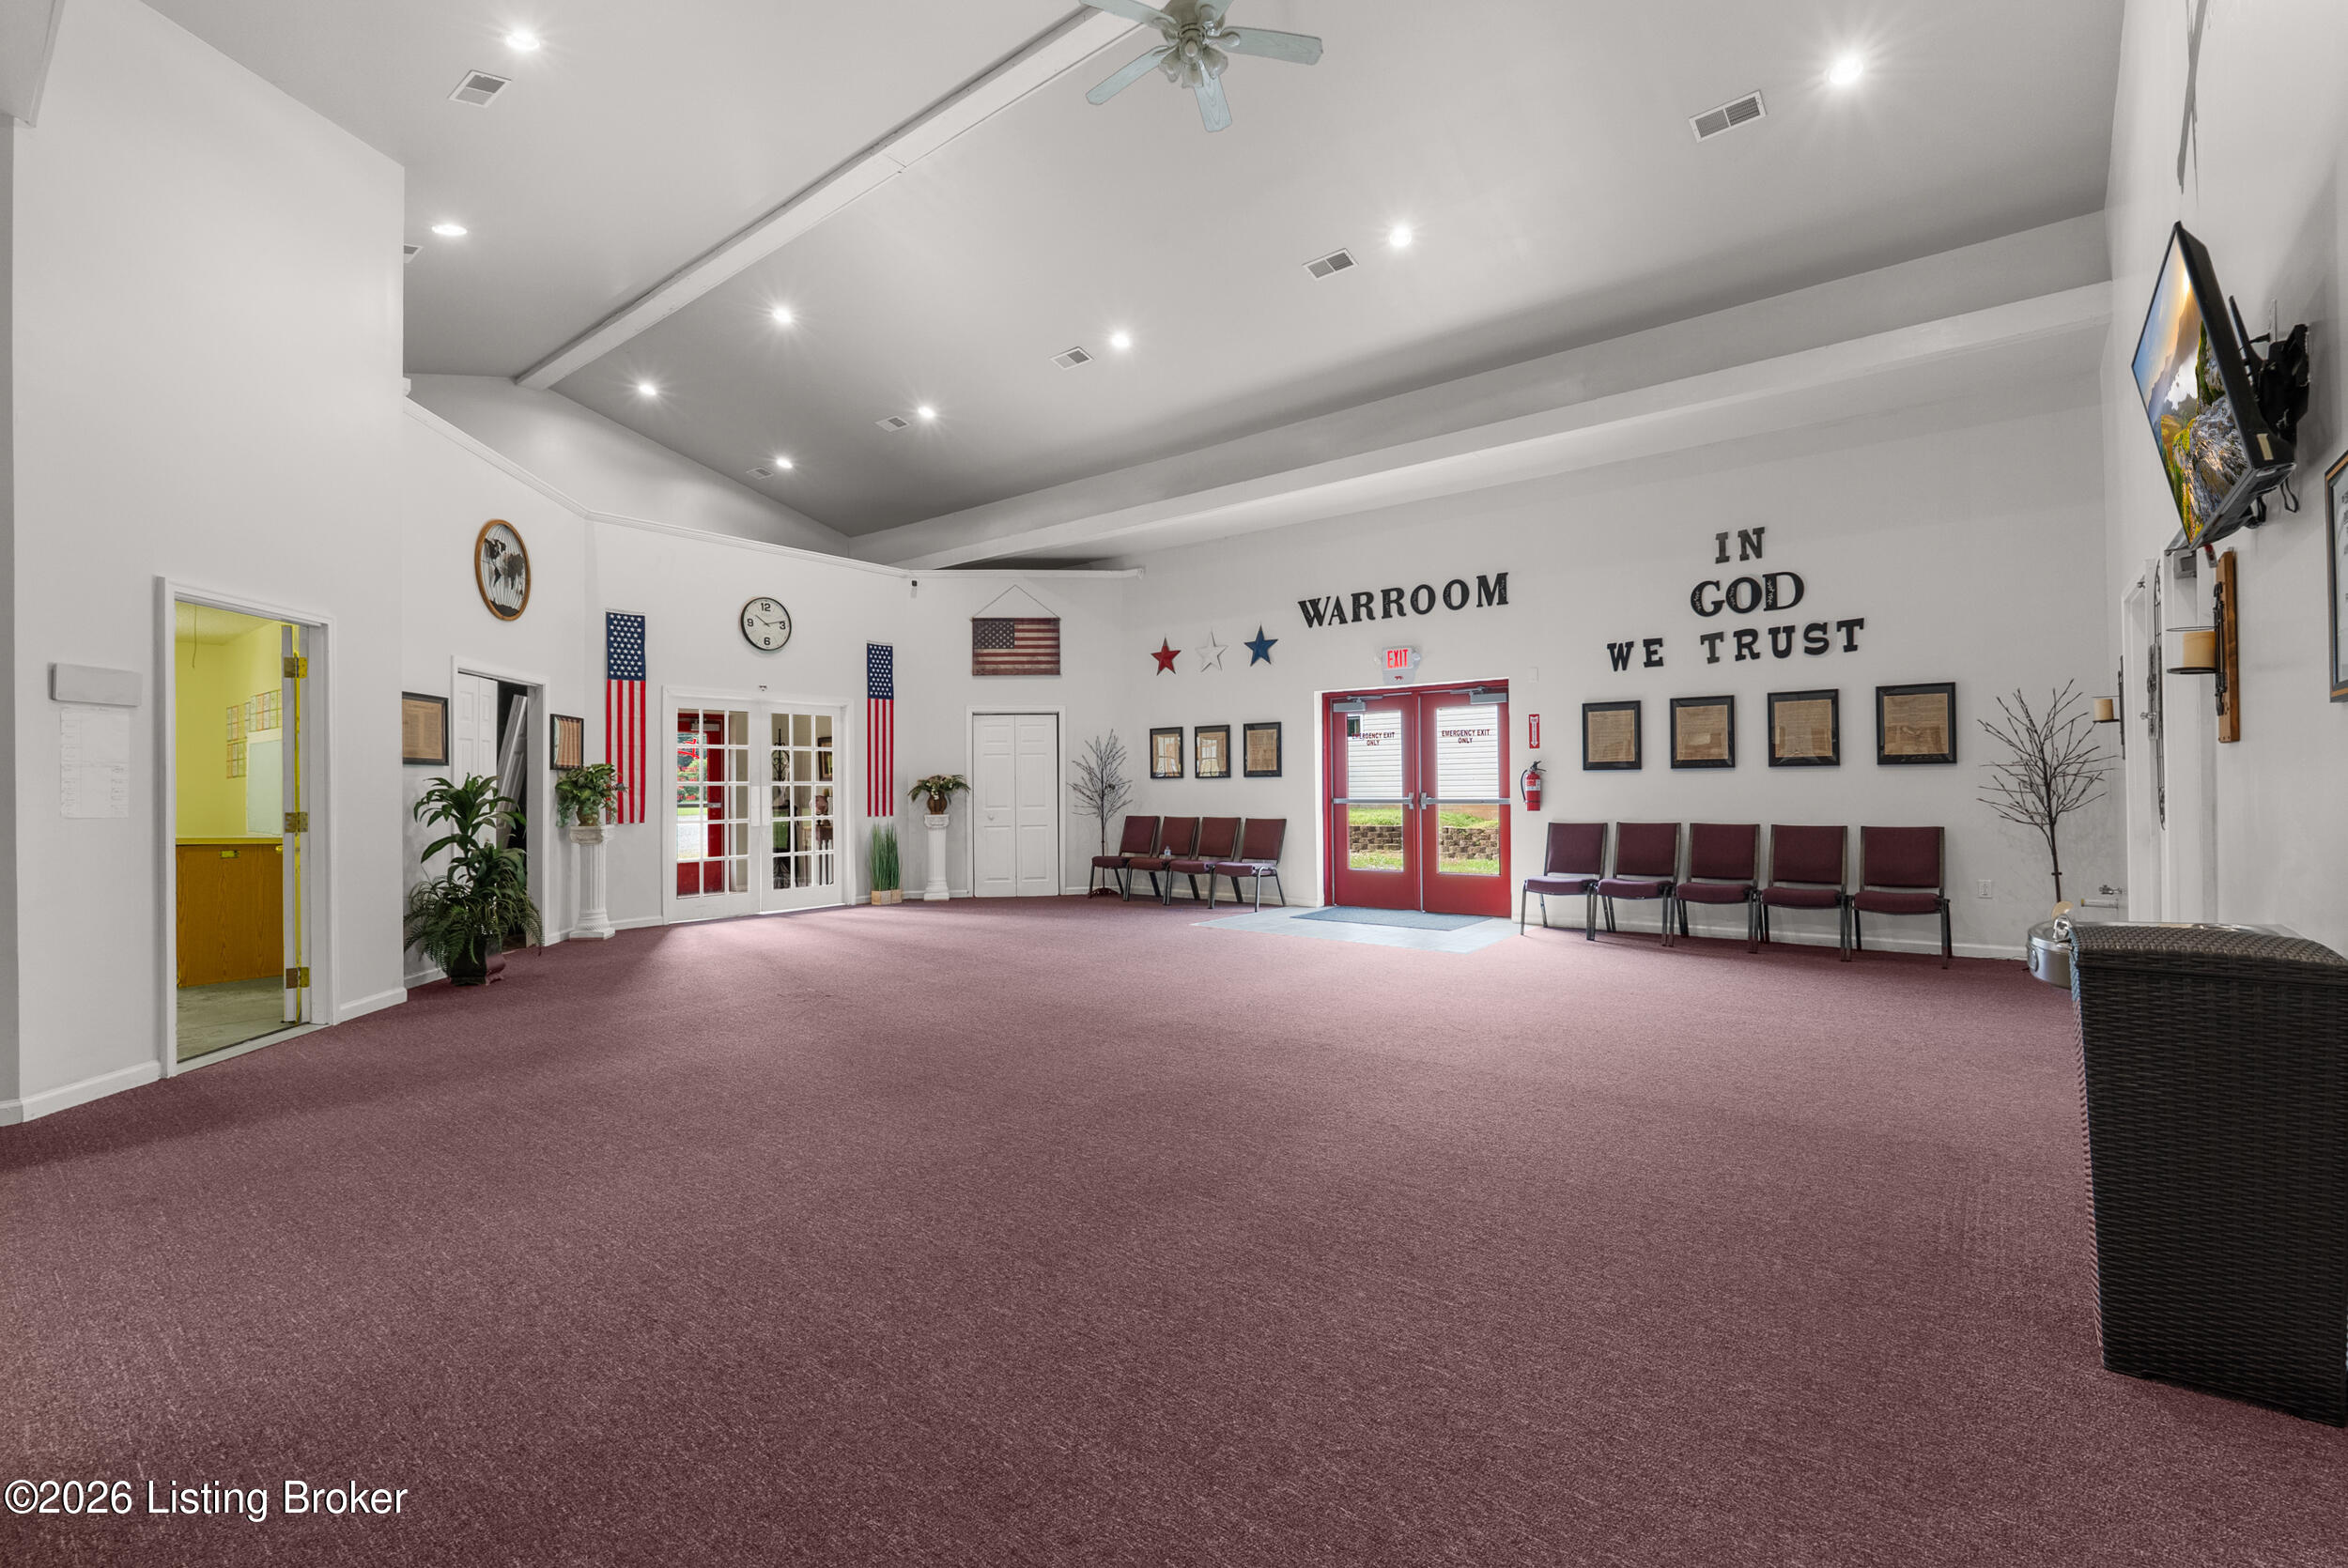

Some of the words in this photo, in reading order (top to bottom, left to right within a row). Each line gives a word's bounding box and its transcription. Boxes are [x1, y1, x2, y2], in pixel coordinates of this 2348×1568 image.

[1715, 527, 1766, 564] IN
[1298, 572, 1509, 628] WARROOM
[1690, 571, 1804, 618] GOD
[761, 603, 771, 611] 12
[747, 618, 754, 627] 9
[780, 621, 786, 630] 3
[764, 637, 771, 646] 6
[1607, 638, 1664, 671] WE
[1700, 618, 1865, 664] TRUST
[1386, 649, 1409, 669] EXIT
